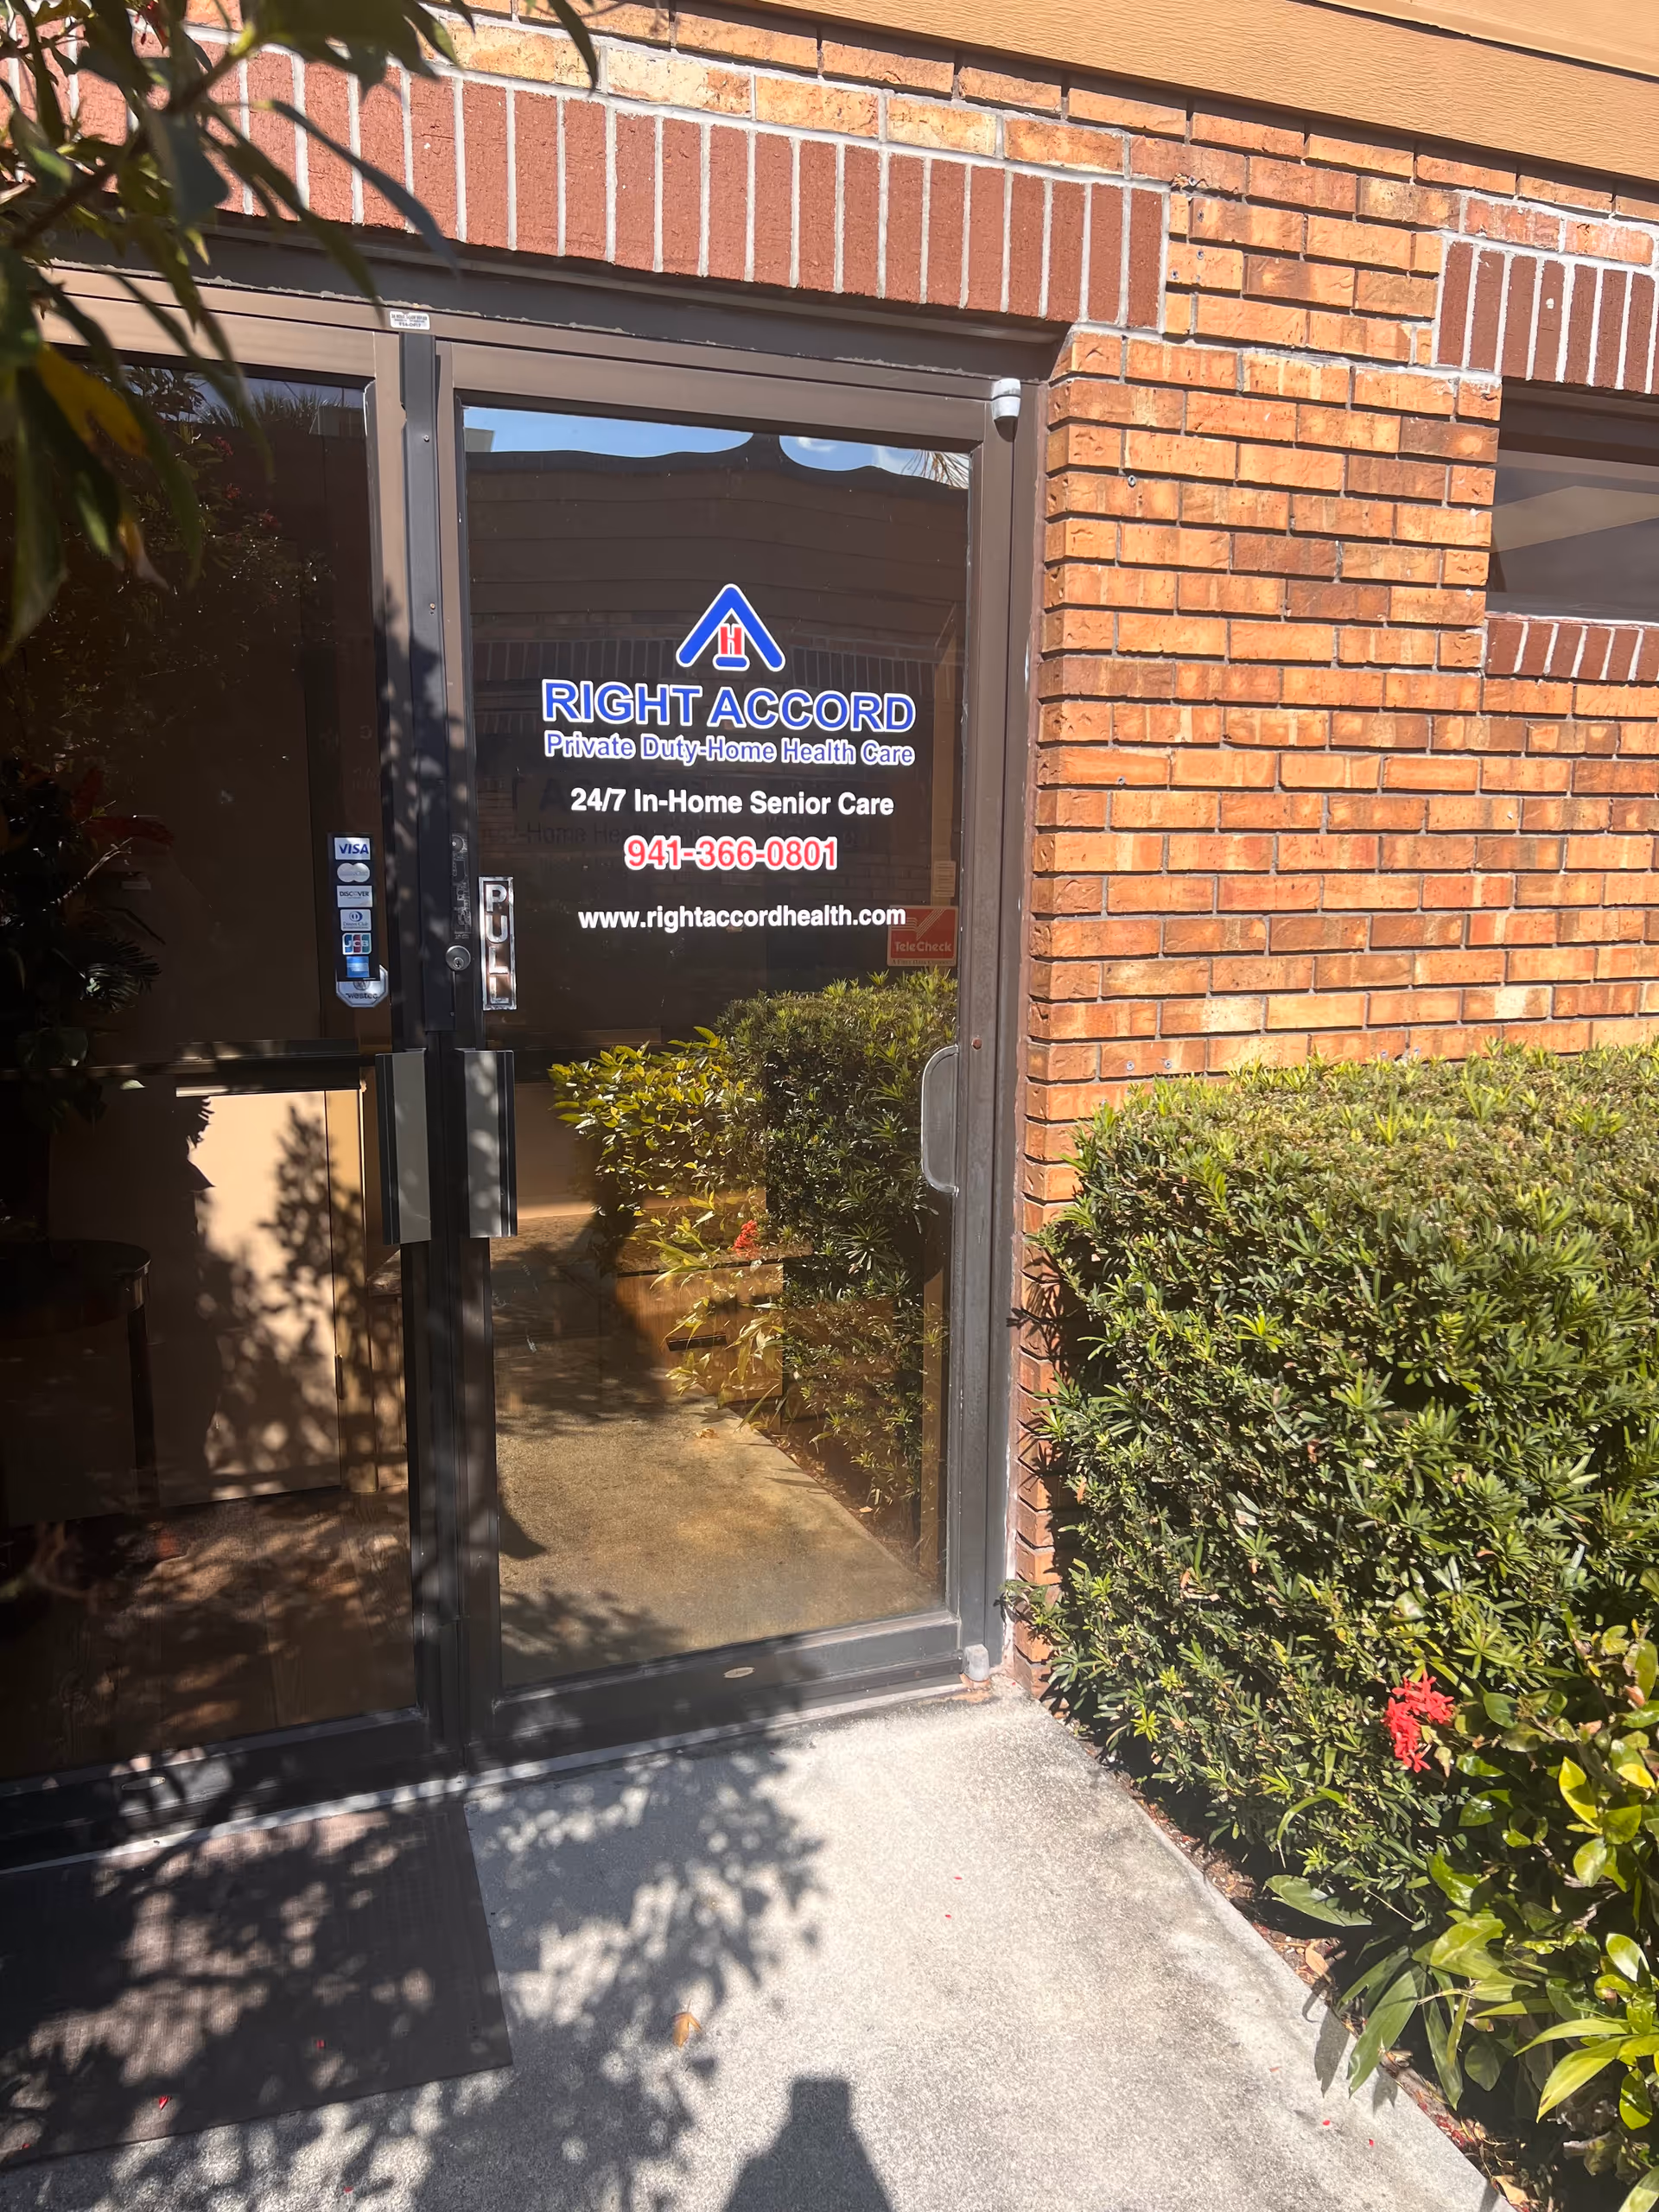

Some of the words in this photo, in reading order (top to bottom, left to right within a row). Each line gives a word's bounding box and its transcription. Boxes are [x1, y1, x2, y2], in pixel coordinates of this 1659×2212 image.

[542, 679, 702, 726] RIGHT
[707, 687, 916, 733] ACCORD
[544, 730, 636, 759] Private
[640, 734, 777, 766] Duty-Home
[781, 736, 855, 765] Health
[861, 740, 916, 766] Care
[570, 787, 626, 812] 24/7
[634, 788, 743, 814] In-Home
[749, 790, 832, 815] Senior
[837, 791, 894, 816] Care
[339, 843, 370, 855] VISA
[623, 835, 838, 871] 941-366-0801
[577, 904, 906, 934] www.rightaccordhealth.com
[486, 883, 510, 1005] PULL
[893, 941, 952, 952] TeleCheck
